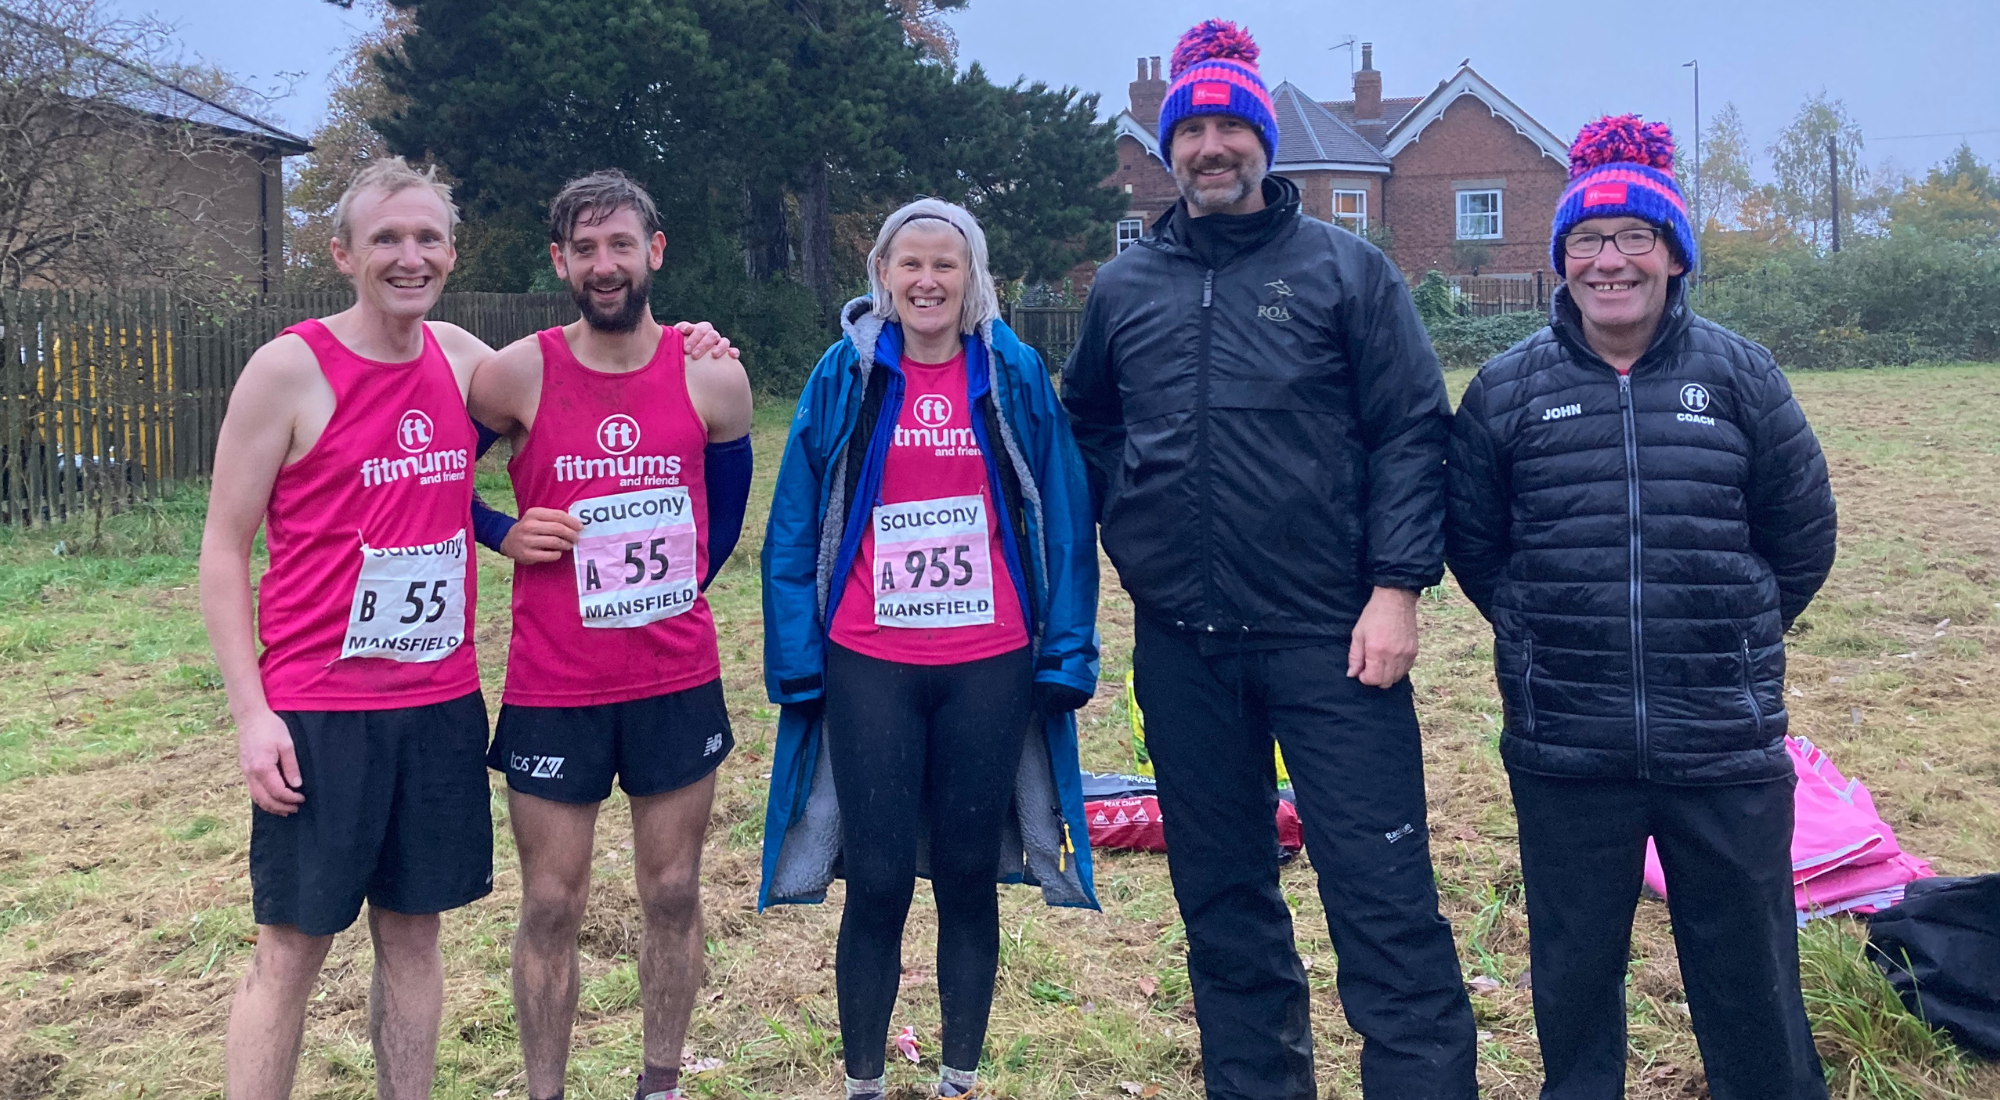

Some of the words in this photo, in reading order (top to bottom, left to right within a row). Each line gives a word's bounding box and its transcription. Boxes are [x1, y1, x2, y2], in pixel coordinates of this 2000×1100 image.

[1257, 305, 1293, 321] ROA
[1685, 388, 1704, 407] ft
[919, 399, 946, 421] ft
[1542, 403, 1582, 420] JOHN
[1676, 413, 1715, 426] COACH
[401, 418, 430, 446] ft
[604, 422, 633, 447] ft
[894, 424, 977, 447] tmum
[935, 447, 955, 457] and
[957, 446, 984, 456] frien
[360, 449, 468, 488] fitmums
[420, 472, 441, 485] and
[443, 470, 466, 483] friend
[553, 455, 682, 482] fitmums
[619, 477, 641, 487] and
[644, 475, 680, 486] friends
[579, 496, 684, 526] saucony
[880, 506, 978, 532] saucony
[586, 558, 602, 591] A
[624, 537, 669, 585] 55
[880, 561, 895, 590] A
[904, 545, 973, 588] 955
[359, 590, 377, 622] B
[399, 580, 448, 624] 55
[585, 588, 694, 619] MANSFIELD
[878, 599, 989, 617] MANSFIELD
[348, 636, 459, 652] MANSFIELD
[1103, 800, 1120, 808] PEAK
[1121, 799, 1142, 807] CHAIR
